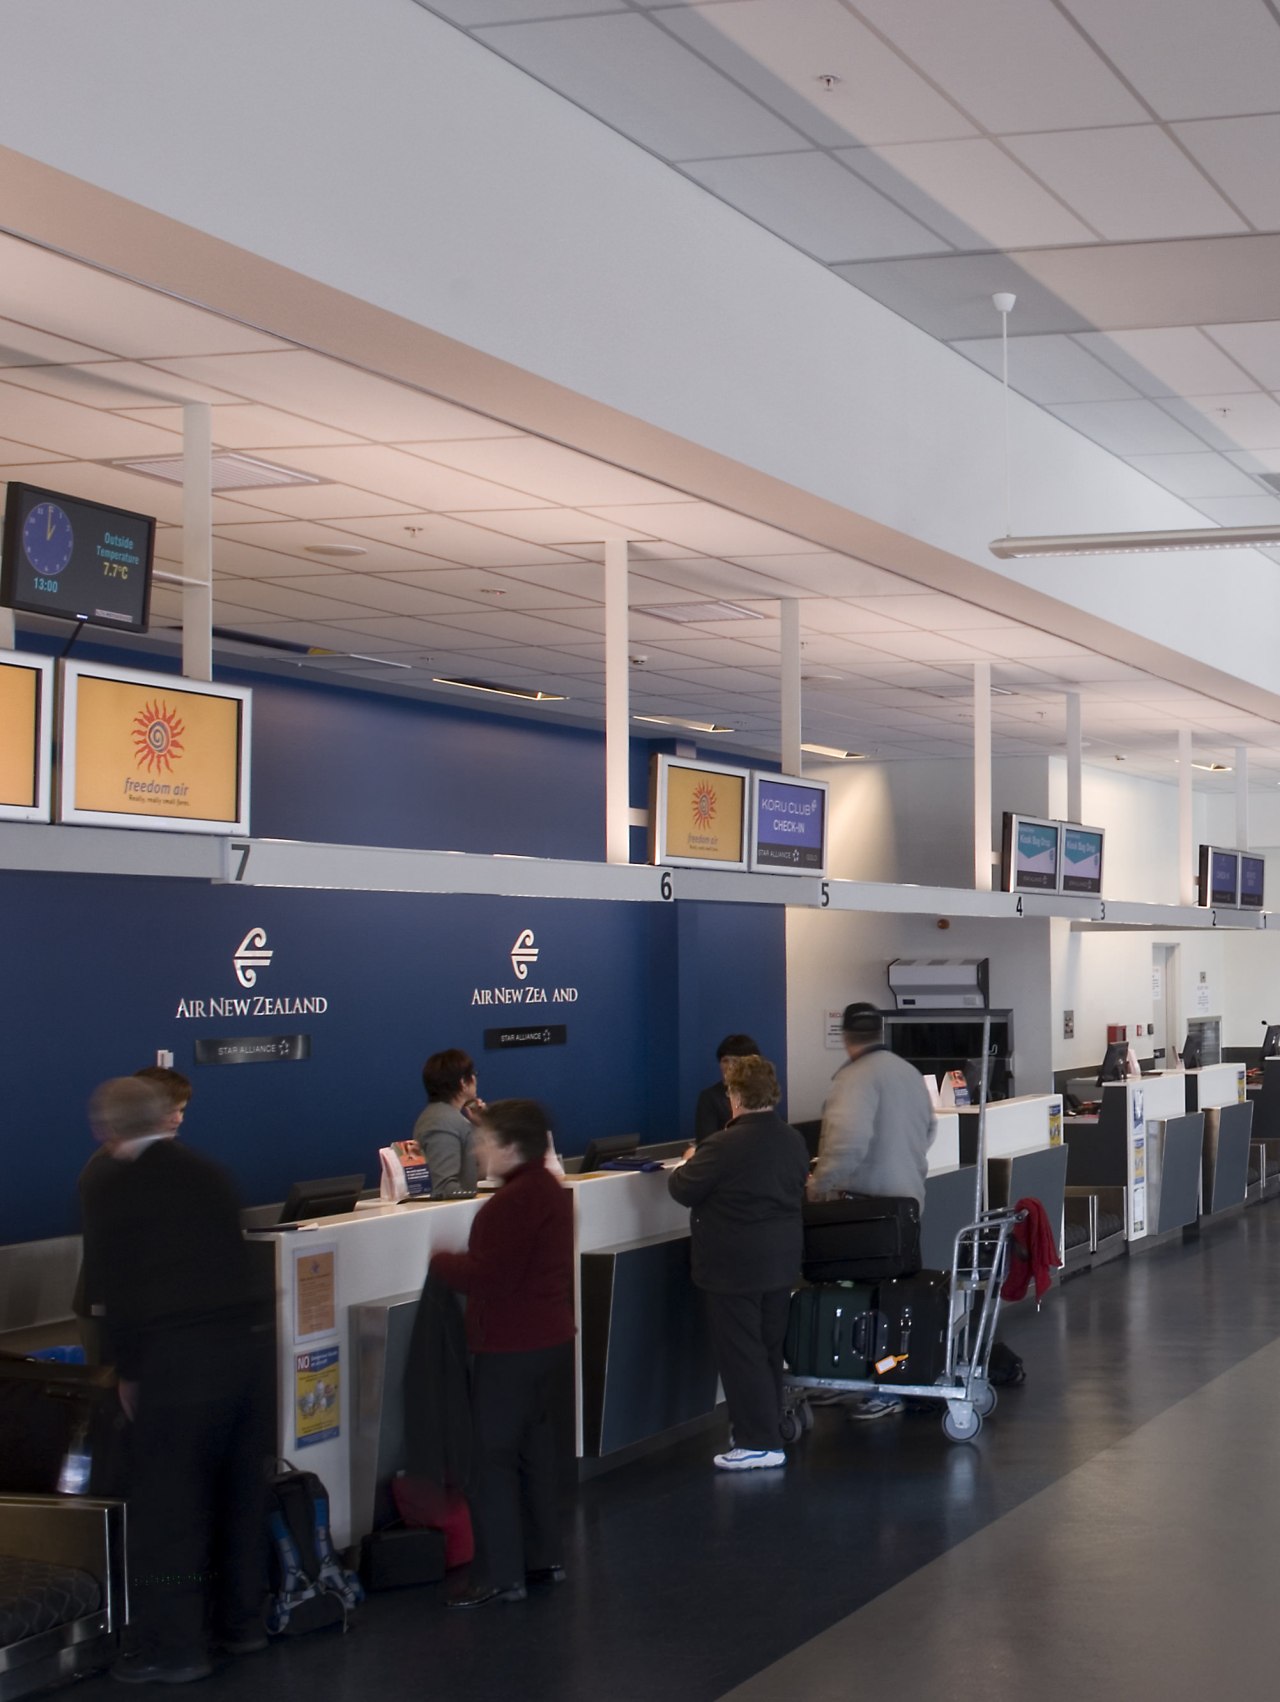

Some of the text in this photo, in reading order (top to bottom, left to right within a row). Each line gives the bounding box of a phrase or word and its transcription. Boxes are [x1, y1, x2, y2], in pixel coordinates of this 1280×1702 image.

[104, 532, 134, 550] Outside
[96, 545, 140, 565] Temperature
[34, 577, 58, 593] 13:00
[124, 778, 189, 796] freedom air
[762, 799, 811, 816] KORU CLUB
[774, 819, 805, 833] CHECK-IN
[232, 844, 250, 881] 7
[661, 872, 672, 900] 6
[822, 882, 830, 907] 5
[1016, 896, 1023, 916] 4
[1100, 902, 1106, 920] 3
[1212, 910, 1216, 927] 2
[1263, 914, 1267, 928] 1
[471, 988, 494, 1006] AIR
[494, 987, 524, 1004] NEW
[176, 996, 328, 1018] AIR NEW ZEALAND
[501, 1032, 542, 1042] STAR ALLIANCE
[218, 1044, 276, 1056] STAR ALLIANCE
[298, 1355, 310, 1370] NO
